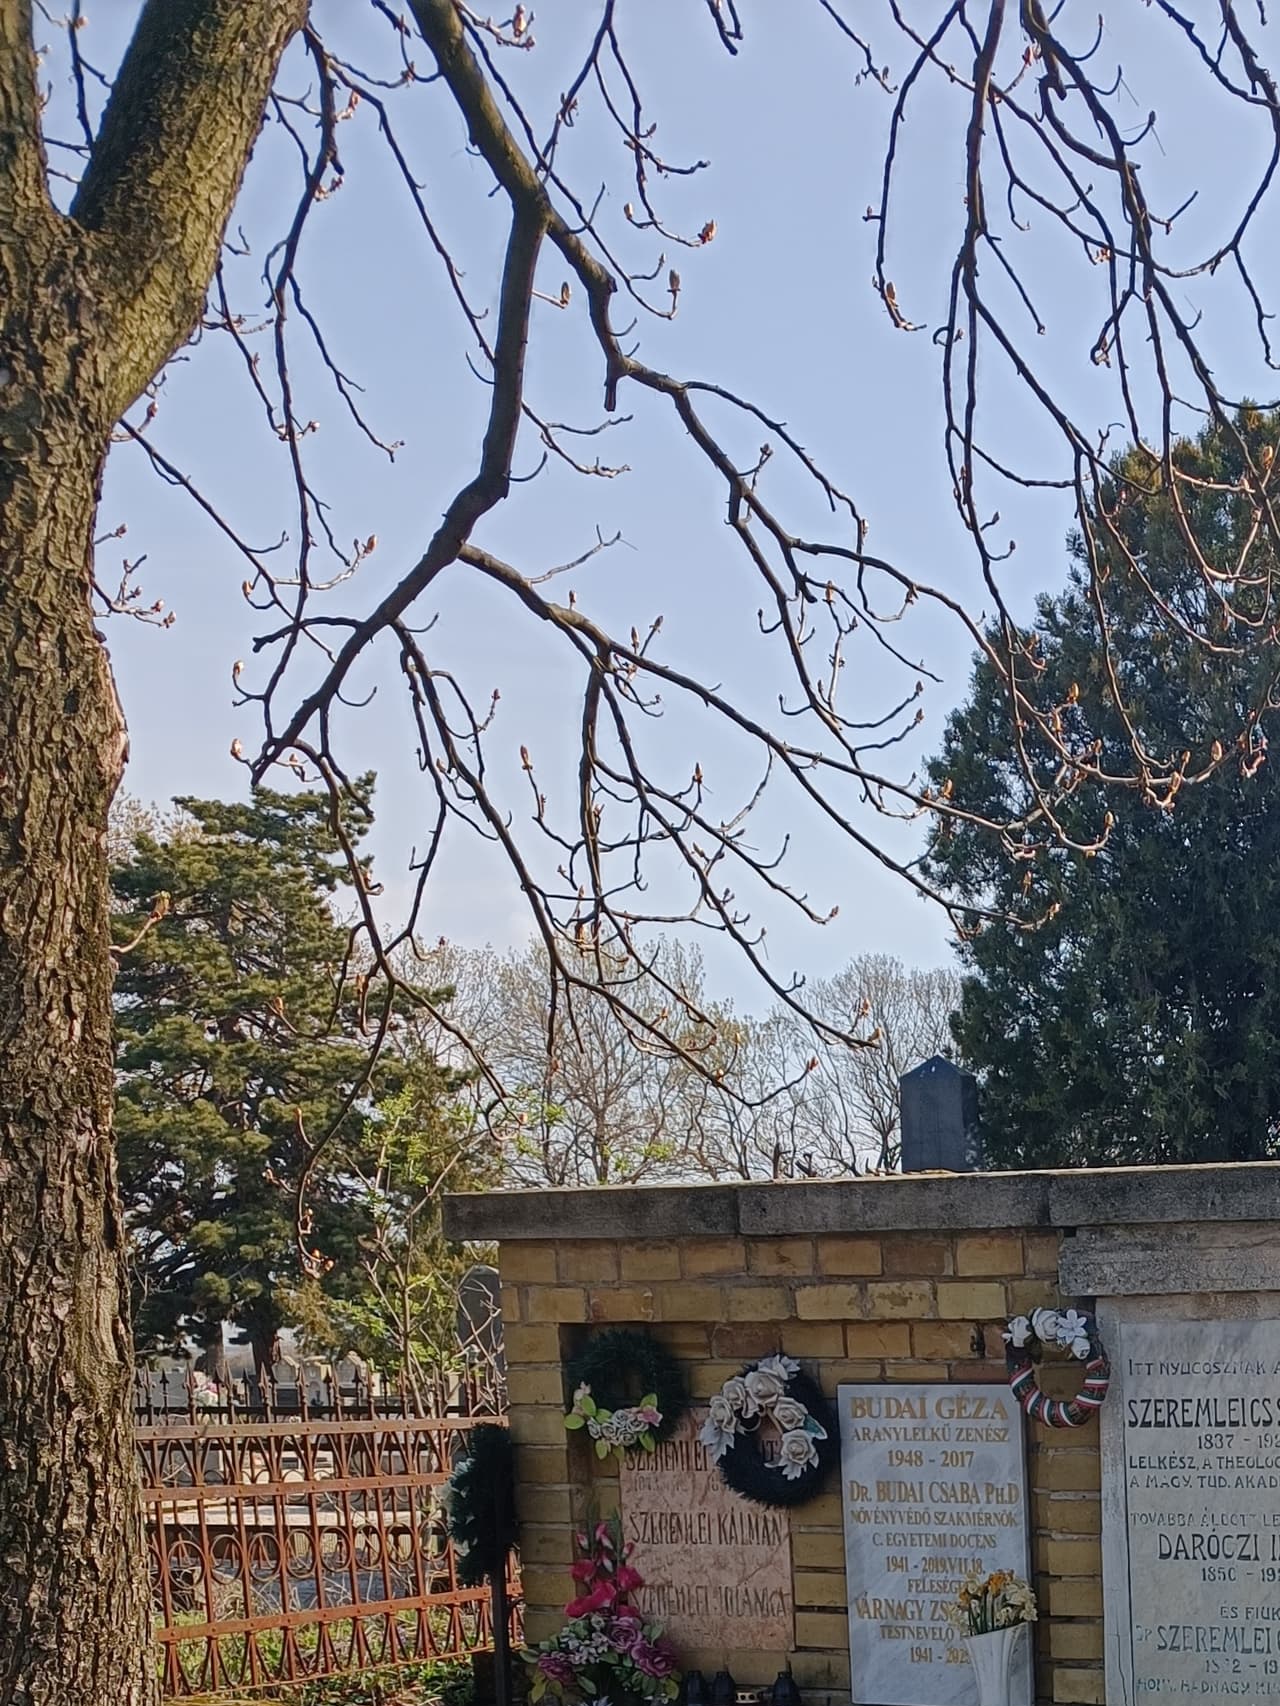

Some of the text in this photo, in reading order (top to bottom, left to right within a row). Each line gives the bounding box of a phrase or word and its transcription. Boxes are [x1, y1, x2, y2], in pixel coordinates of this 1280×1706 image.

[850, 1390, 1009, 1420] BUDAI GÉZA
[955, 1424, 1009, 1442] ZENÉSZ
[1197, 1433, 1235, 1450] 1837
[887, 1450, 924, 1468] 1948
[940, 1450, 975, 1469] 2017
[1202, 1455, 1213, 1470] A
[876, 1480, 925, 1504] BUDAI
[928, 1481, 981, 1506] CSABA
[886, 1532, 947, 1549] EGYETEMI
[950, 1533, 998, 1550] DOCENS
[1158, 1528, 1261, 1562] DARÓCZI
[855, 1591, 926, 1622] VÁRNAGY
